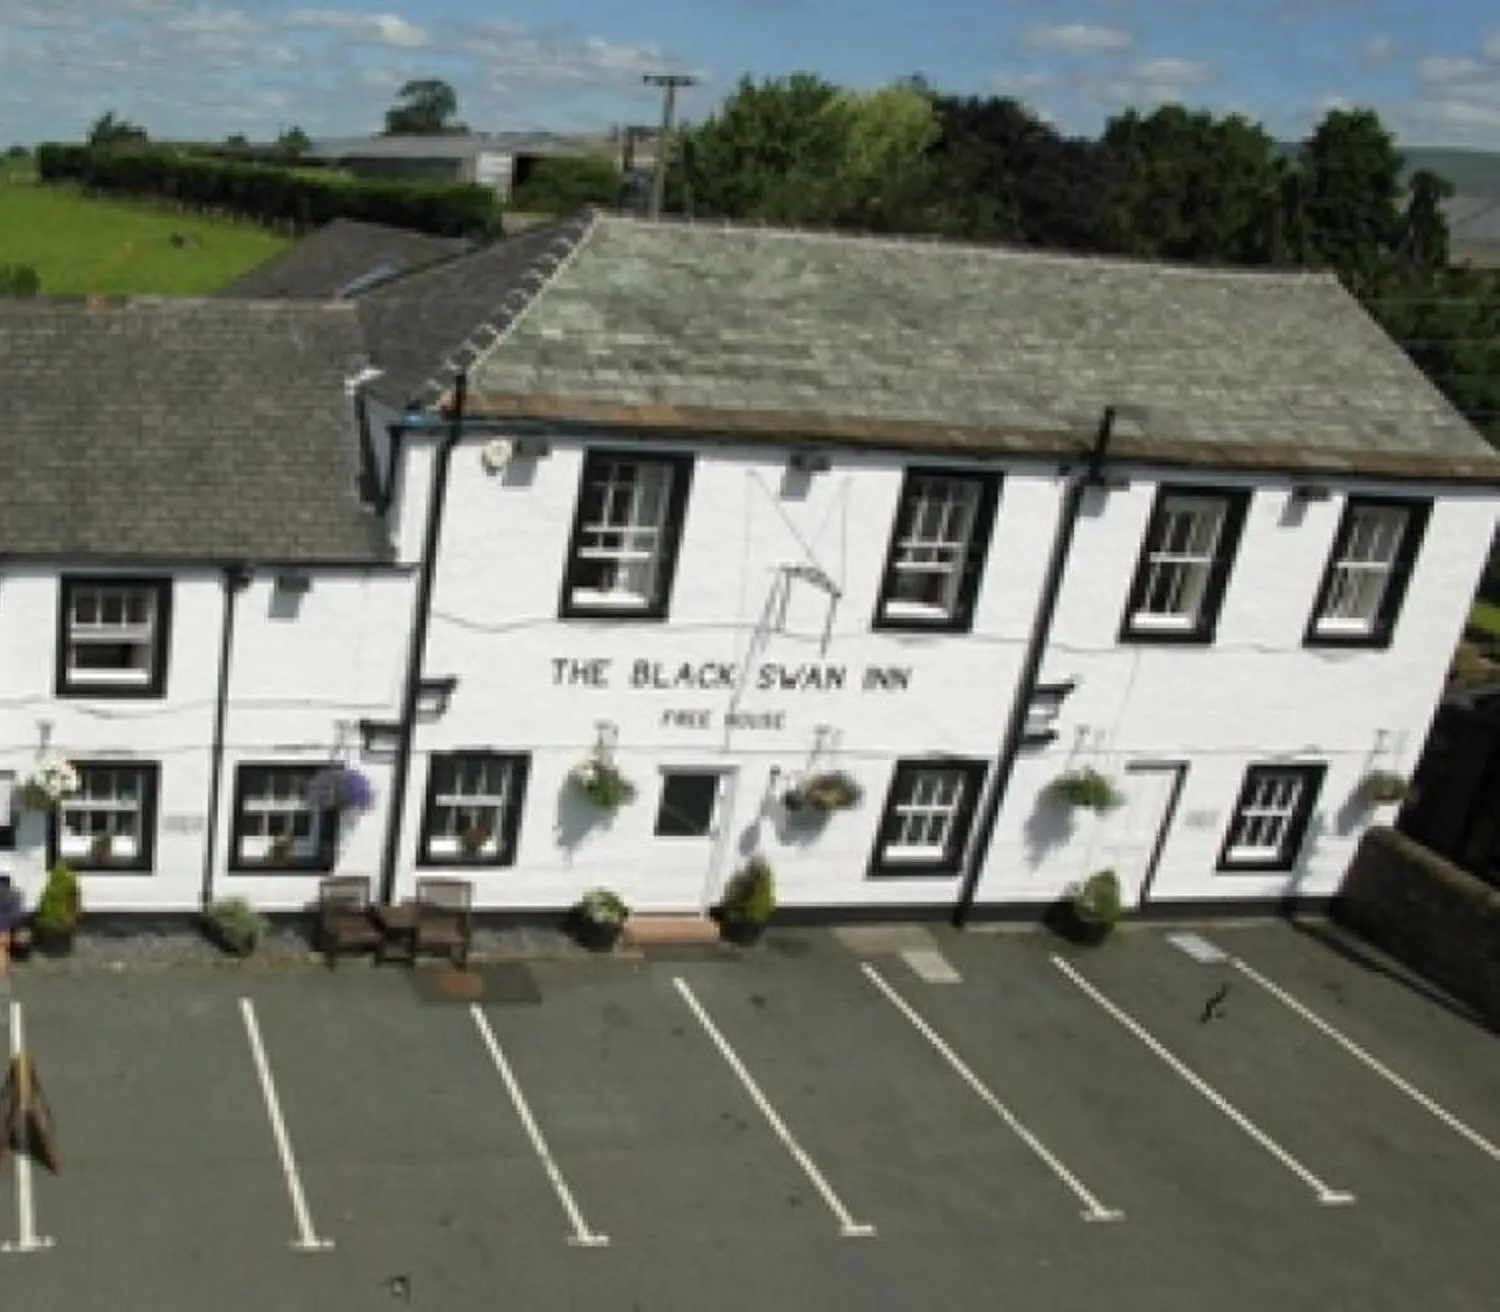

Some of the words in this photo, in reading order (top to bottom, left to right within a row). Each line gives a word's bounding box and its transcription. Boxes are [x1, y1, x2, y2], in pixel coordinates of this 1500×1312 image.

[551, 657, 611, 687] THE
[629, 657, 736, 689] BLACK
[756, 662, 846, 690] SWAN
[862, 665, 912, 690] INN
[660, 708, 711, 729] FREE
